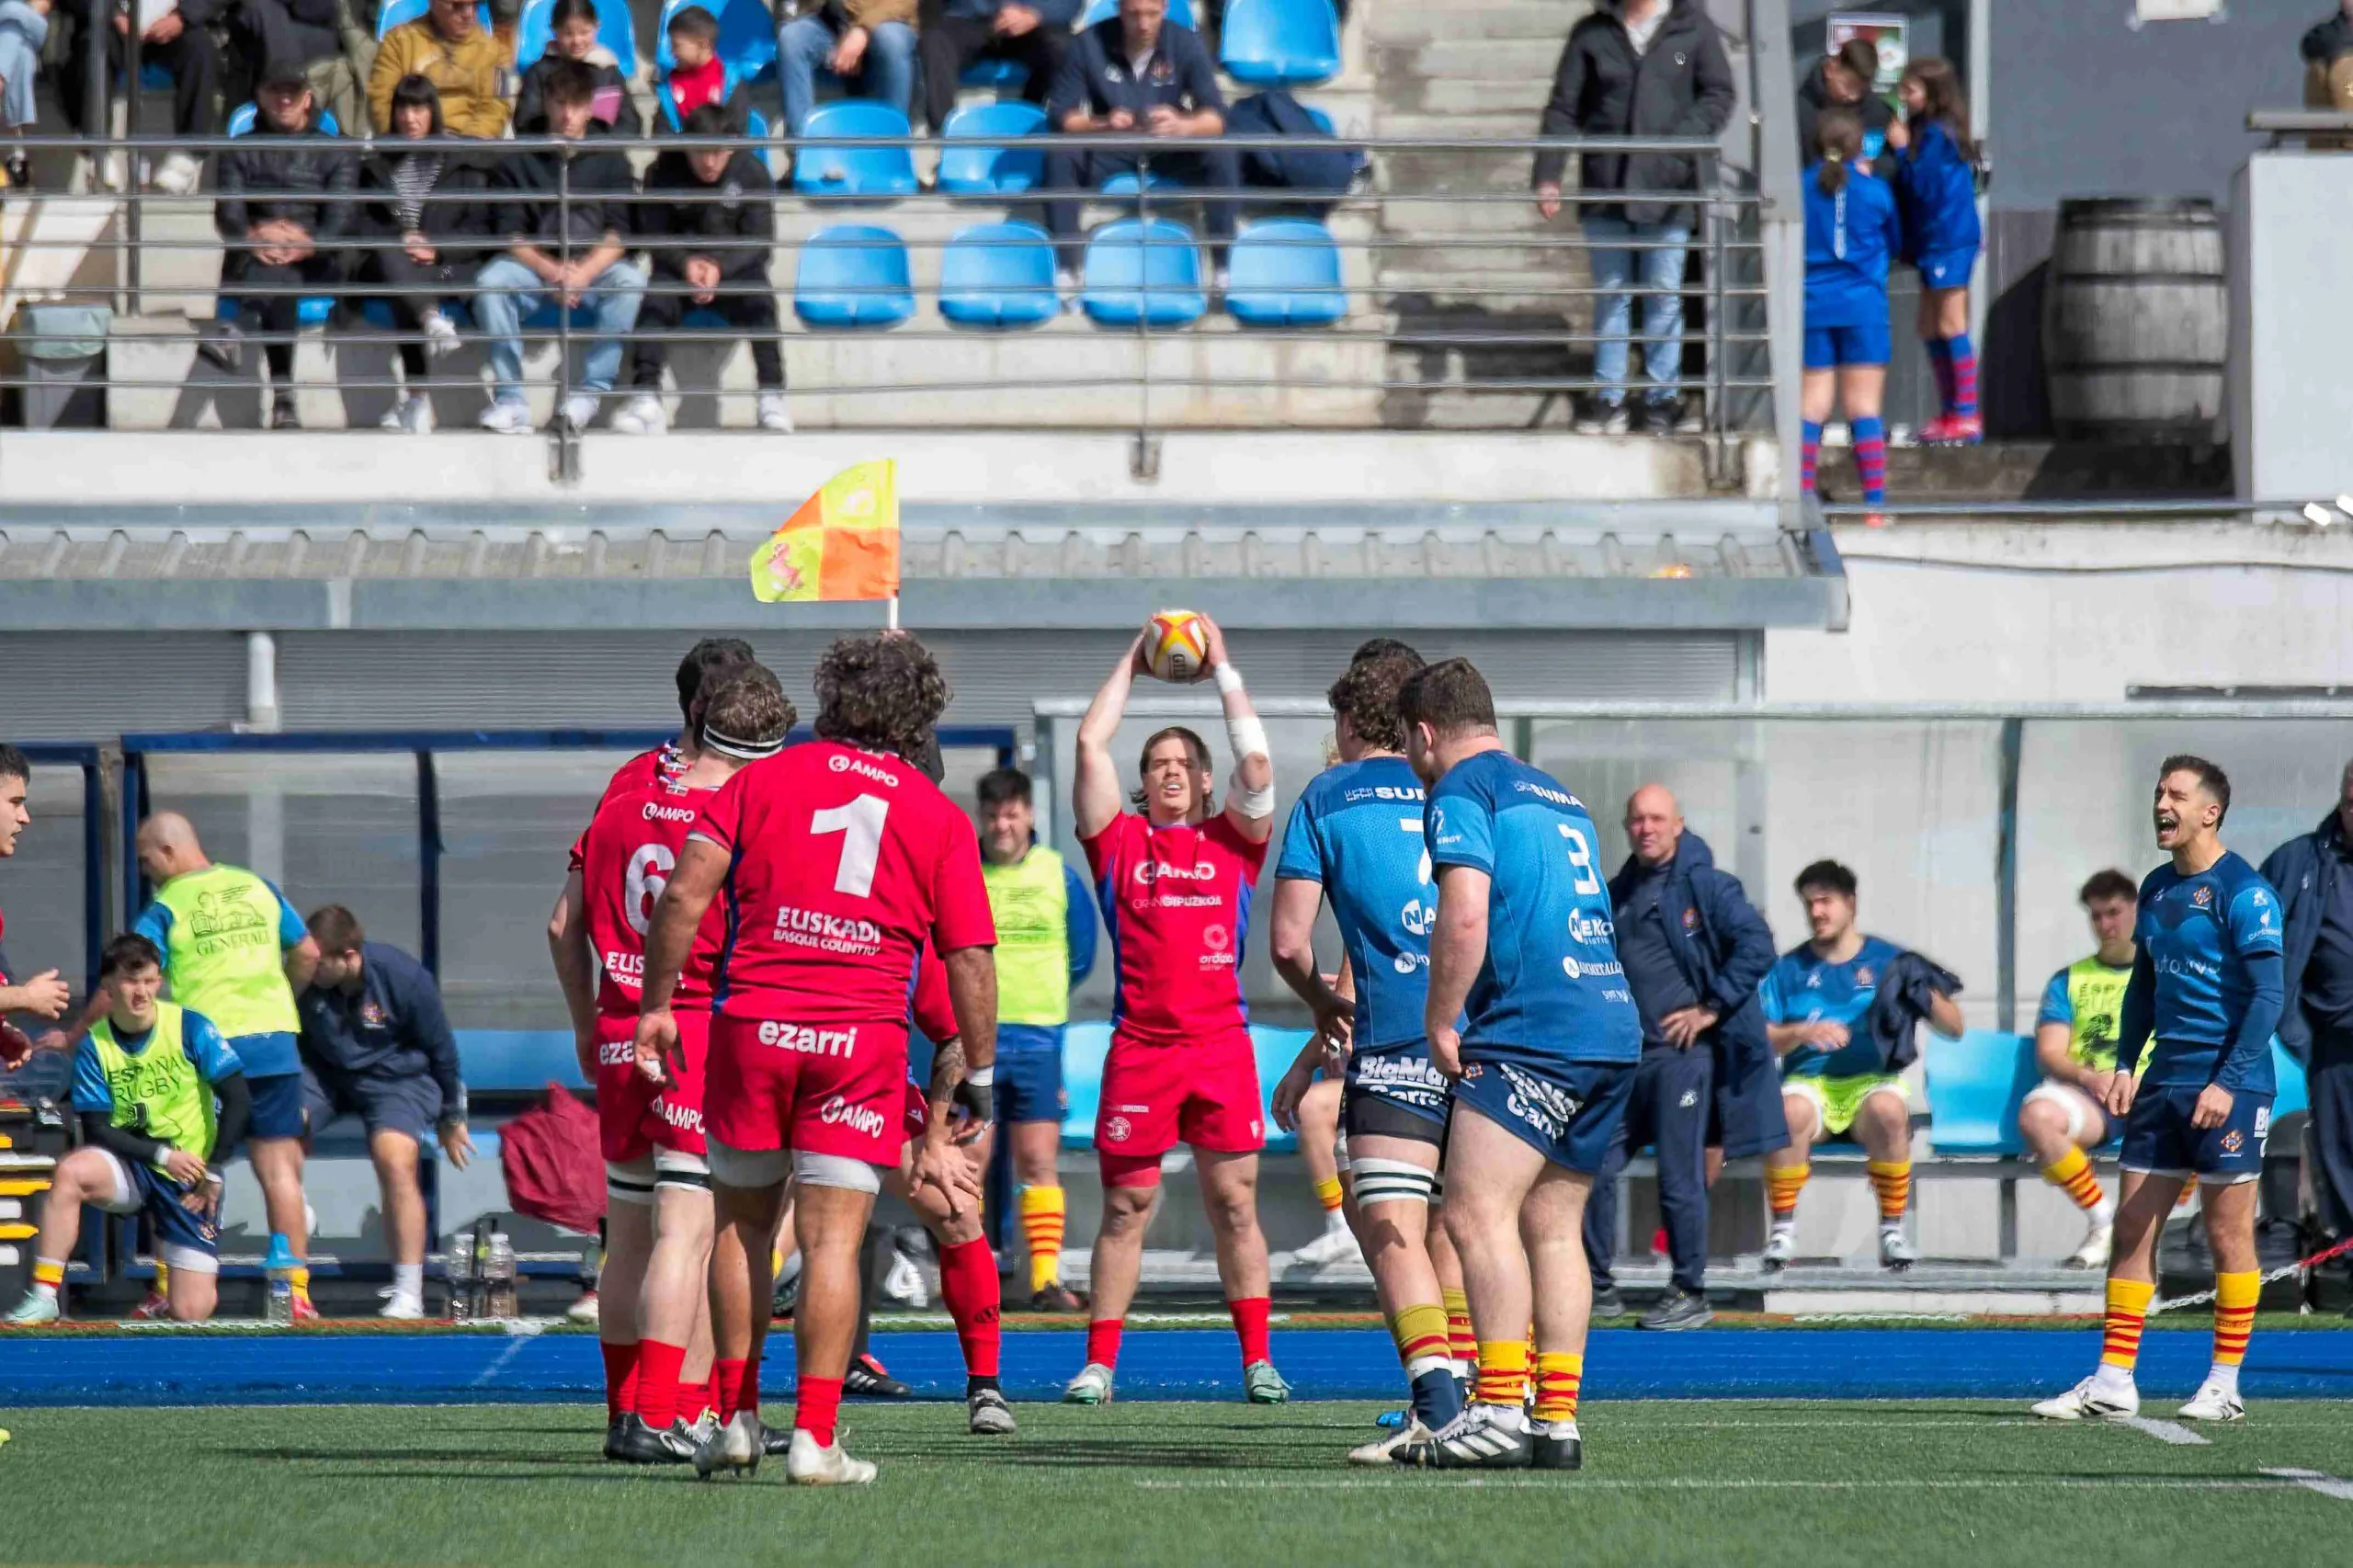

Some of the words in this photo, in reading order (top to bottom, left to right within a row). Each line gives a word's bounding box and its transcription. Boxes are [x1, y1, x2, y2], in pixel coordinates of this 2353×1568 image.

[849, 759, 900, 788] AMPO
[655, 806, 696, 823] AMPO
[810, 793, 891, 899] 1
[1558, 824, 1600, 895] 3
[626, 843, 676, 937] 6
[773, 928, 819, 949] BASQUE
[776, 905, 881, 944] EUSKADI
[196, 929, 270, 957] GENERALI
[758, 1019, 858, 1058] ezarri
[839, 1105, 885, 1139] AMPO
